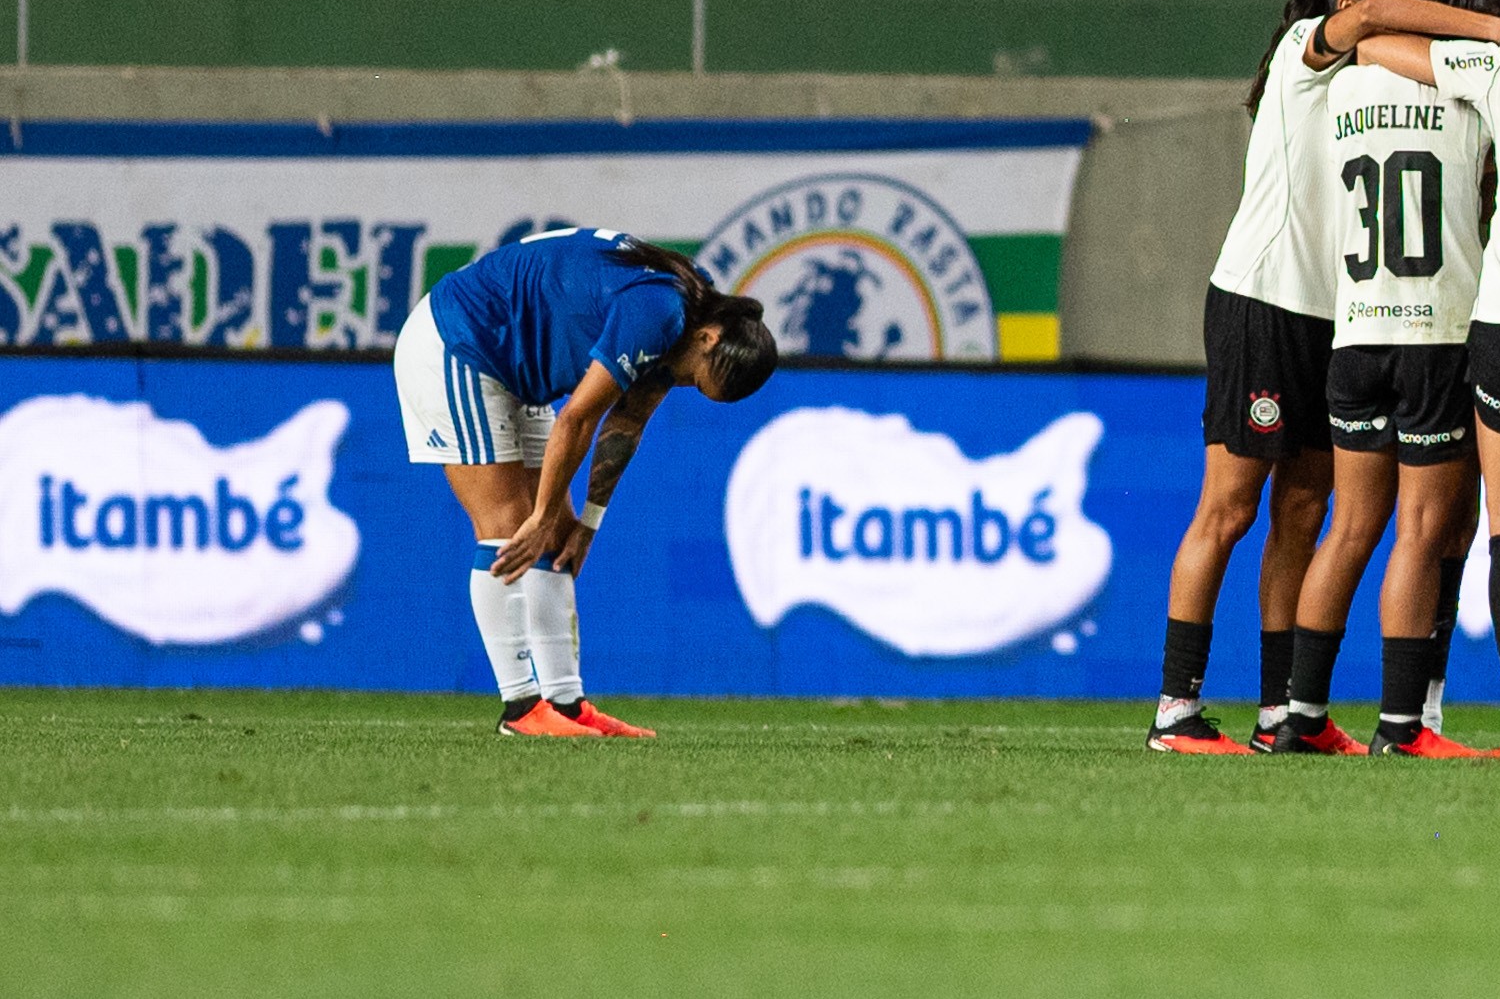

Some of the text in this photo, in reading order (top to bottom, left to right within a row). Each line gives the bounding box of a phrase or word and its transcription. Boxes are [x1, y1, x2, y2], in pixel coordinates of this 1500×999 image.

[1455, 54, 1495, 72] bmg
[1335, 104, 1446, 141] JAQUELINE
[1340, 149, 1444, 284] 30
[1357, 302, 1434, 319] Remessa
[38, 474, 306, 553] itambé
[798, 486, 1057, 564] itambé
